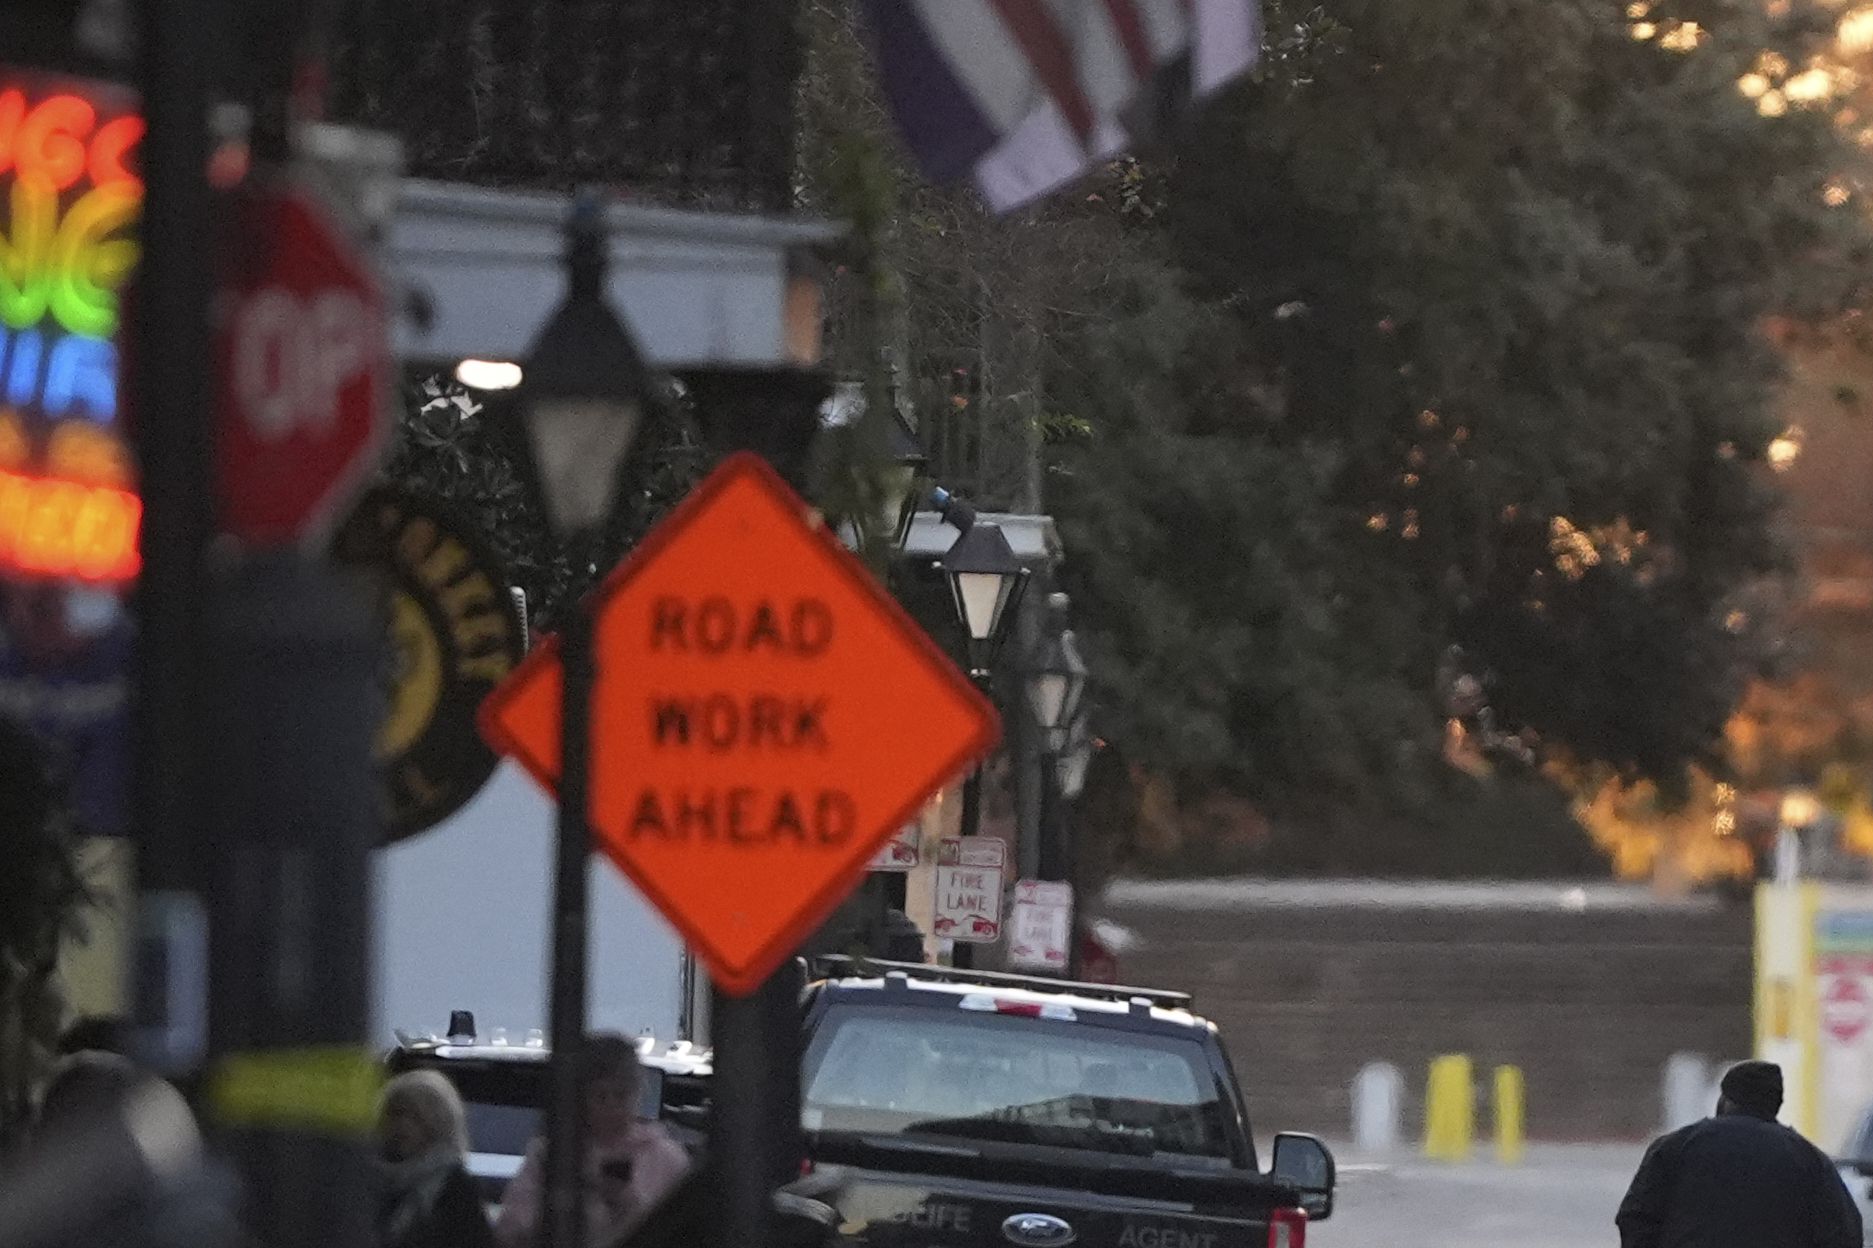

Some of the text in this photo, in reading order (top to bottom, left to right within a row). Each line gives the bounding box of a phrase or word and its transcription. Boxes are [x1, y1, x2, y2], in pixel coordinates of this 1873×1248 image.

[236, 290, 368, 438] OP
[653, 597, 834, 656] ROAD
[651, 695, 829, 751] WORK
[630, 787, 856, 845] AHEAD
[947, 894, 986, 912] LANE
[951, 872, 984, 890] FIRE
